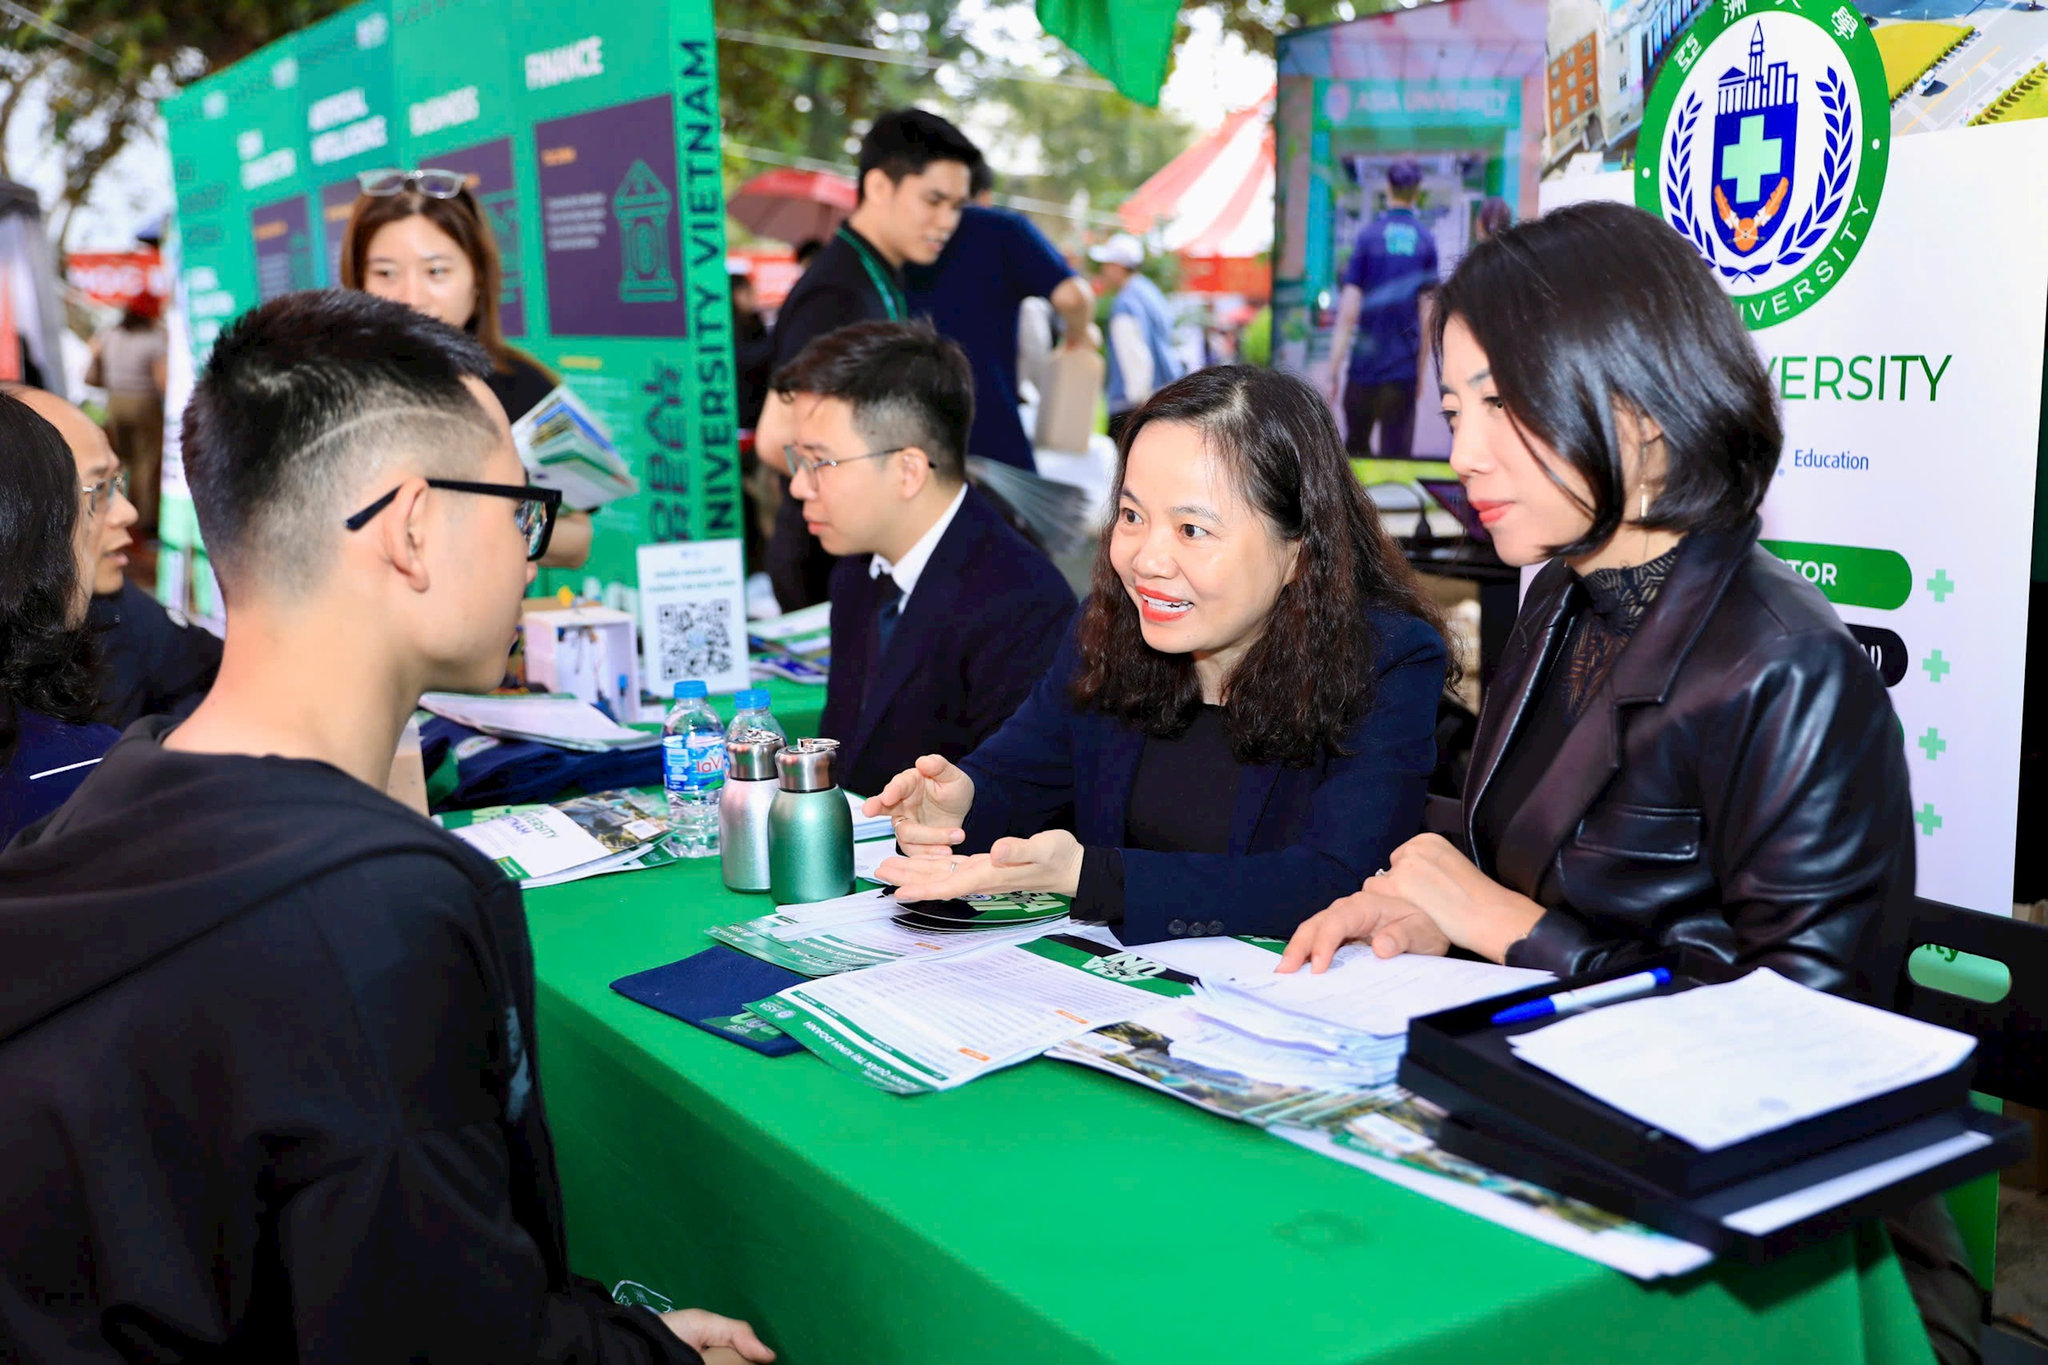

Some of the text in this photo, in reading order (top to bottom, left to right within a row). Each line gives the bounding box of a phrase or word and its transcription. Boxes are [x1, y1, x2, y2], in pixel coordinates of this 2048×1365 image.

[524, 35, 604, 90] FINANCE
[680, 40, 720, 267] VIETNAM
[695, 284, 735, 541] NIVERSITY
[1794, 448, 1869, 470] Education
[1779, 558, 1838, 586] TOR
[802, 1020, 836, 1044] DOANH
[830, 1039, 855, 1058] KINH
